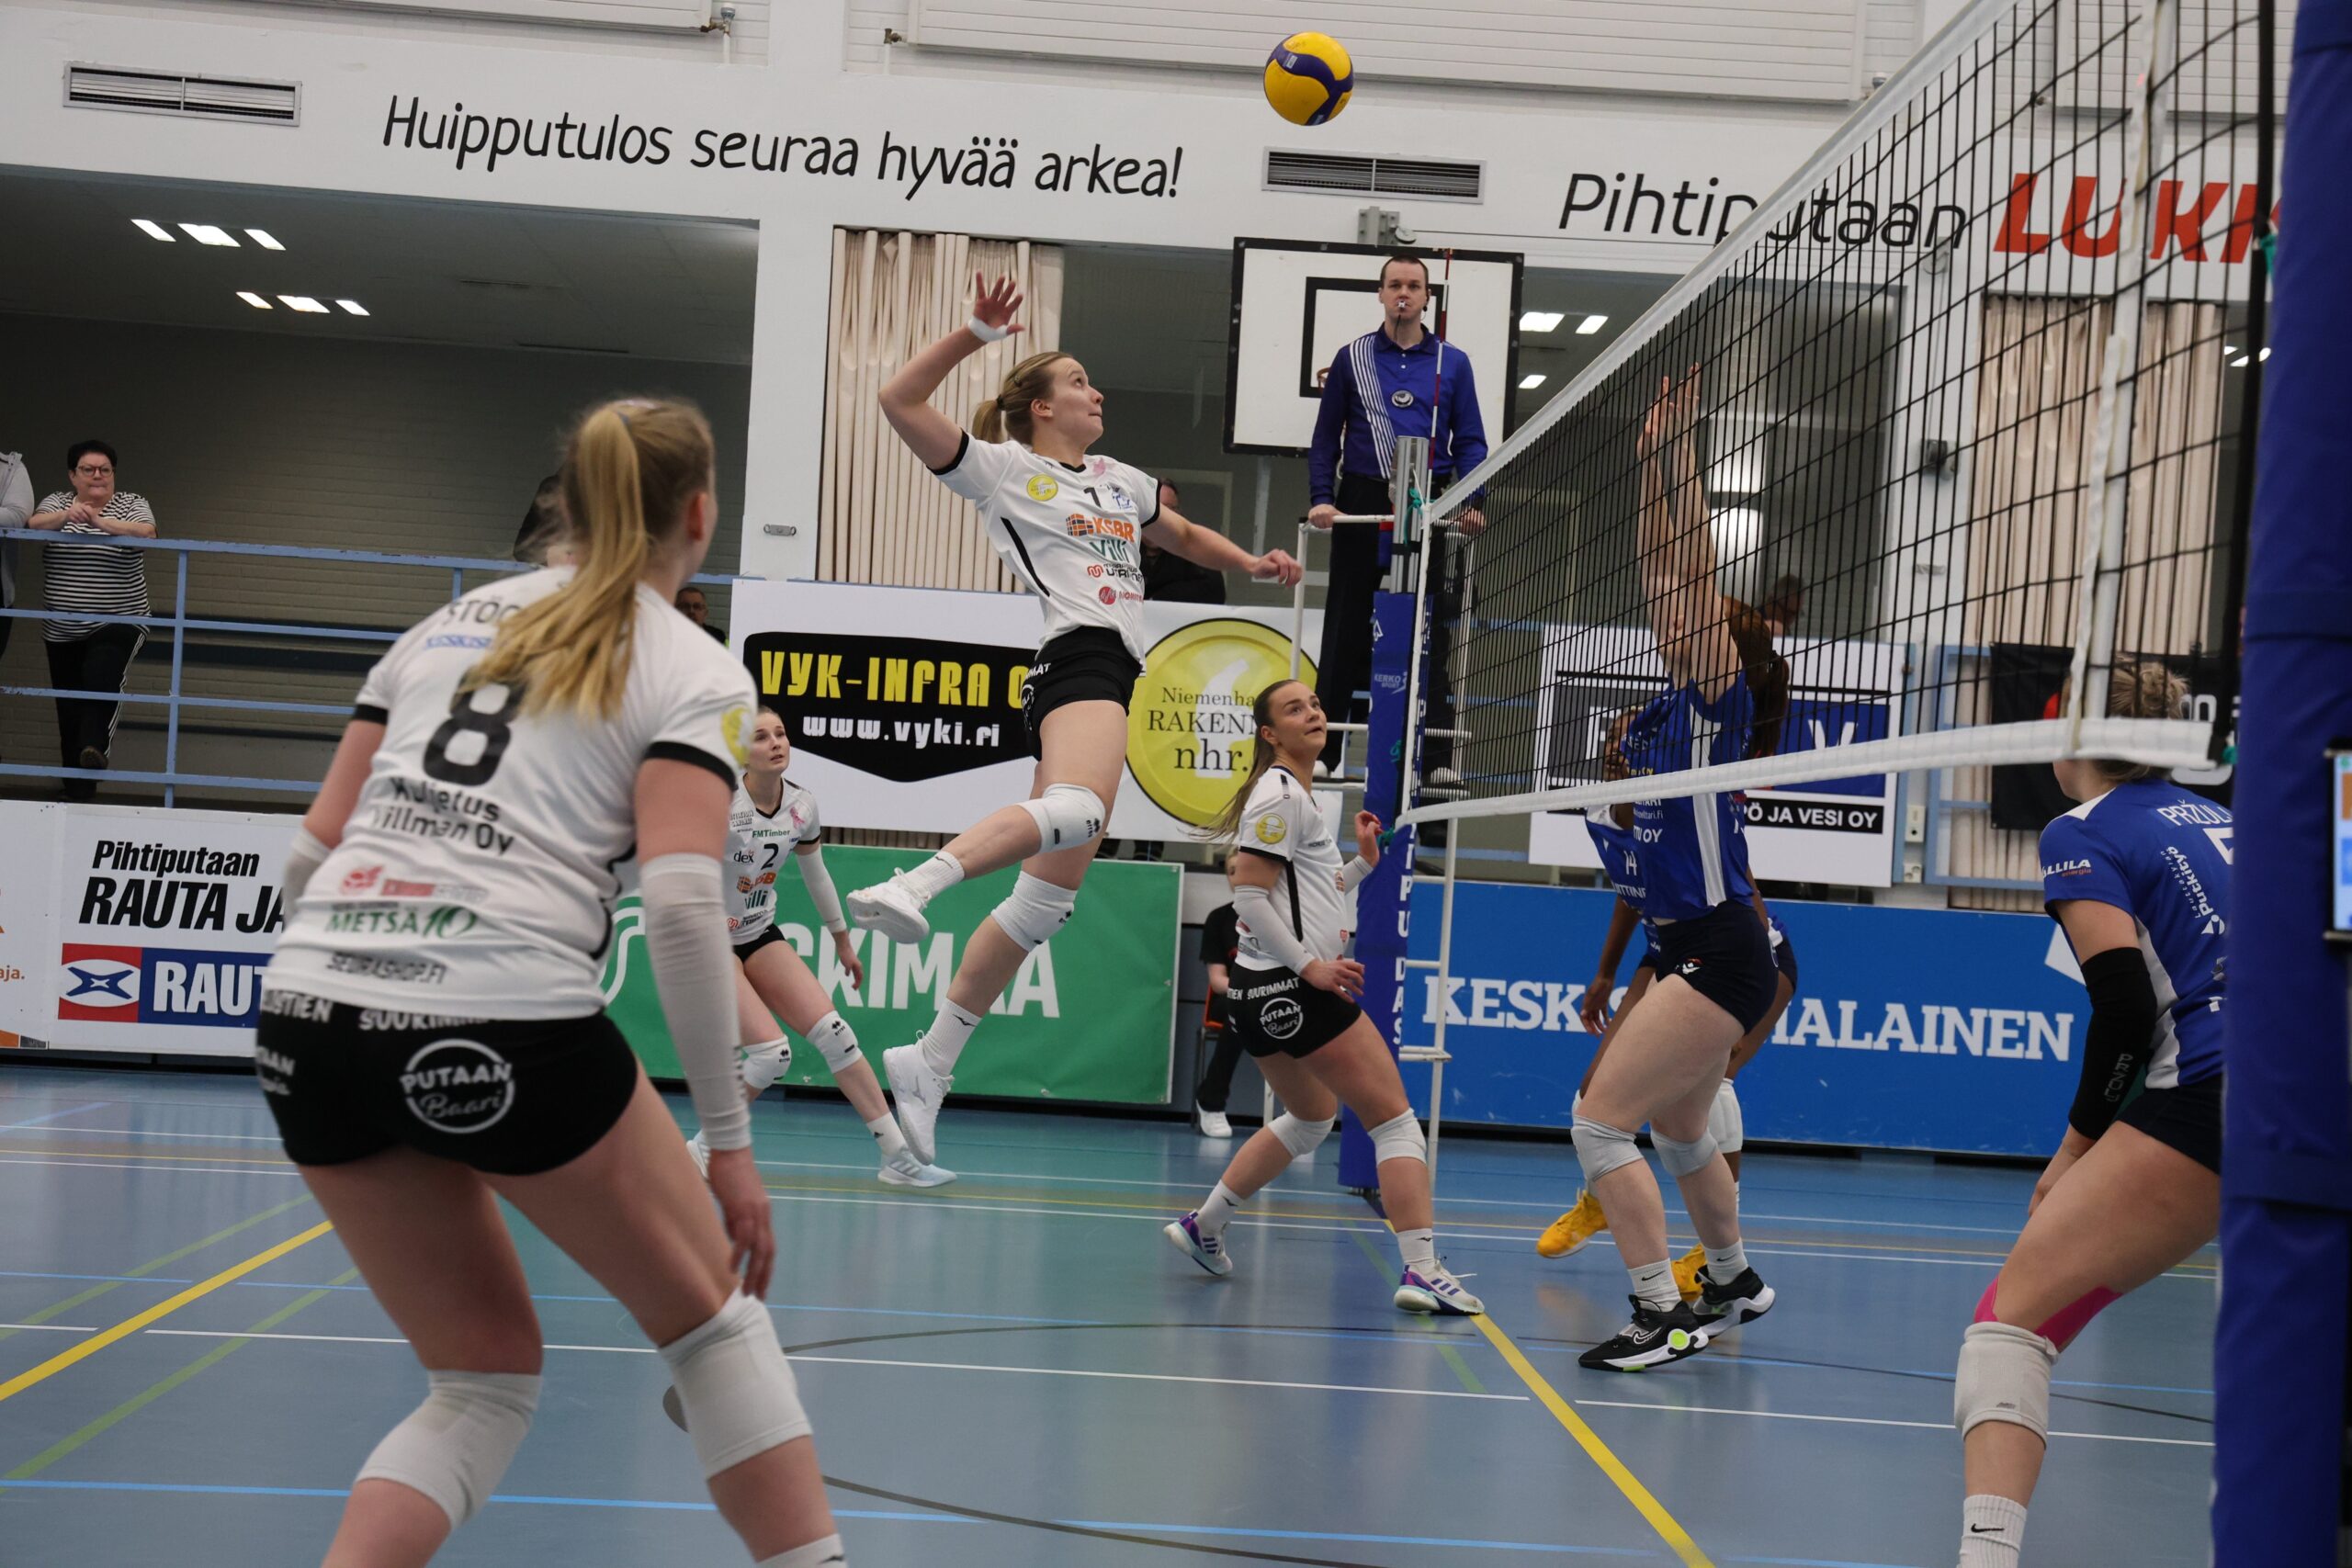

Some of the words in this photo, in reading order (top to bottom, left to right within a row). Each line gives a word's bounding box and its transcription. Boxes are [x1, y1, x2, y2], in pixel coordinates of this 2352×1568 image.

[383, 95, 673, 172] Huipputulos
[690, 129, 859, 176] seuraa
[877, 130, 1018, 201] hyvää
[1035, 143, 1182, 197] arkea!
[761, 650, 990, 707] VYK-INFRA
[1008, 665, 1029, 709] O
[1161, 686, 1256, 706] Niemenha
[424, 669, 530, 786] 8
[803, 716, 1000, 749] www.vyki.fi
[1744, 802, 1763, 822] Ö
[1768, 807, 1797, 825] JA
[1800, 809, 1844, 826] VESI
[1849, 812, 1878, 829] OY
[2157, 799, 2233, 827] PRŽUL
[475, 823, 514, 855] Oy
[1643, 828, 1664, 843] OY
[92, 840, 260, 877] Pihtiputaan
[760, 842, 780, 870] 2
[1623, 850, 1638, 877] 14
[2165, 845, 2214, 916] Putkityö
[79, 876, 229, 931] RAUTA
[775, 922, 1060, 1018] KIMA
[1260, 1005, 1302, 1026] PUTAAN
[1422, 975, 2075, 1062] KESKALAINEN
[399, 1063, 513, 1094] PUTAAN
[419, 1090, 503, 1119] Baari
